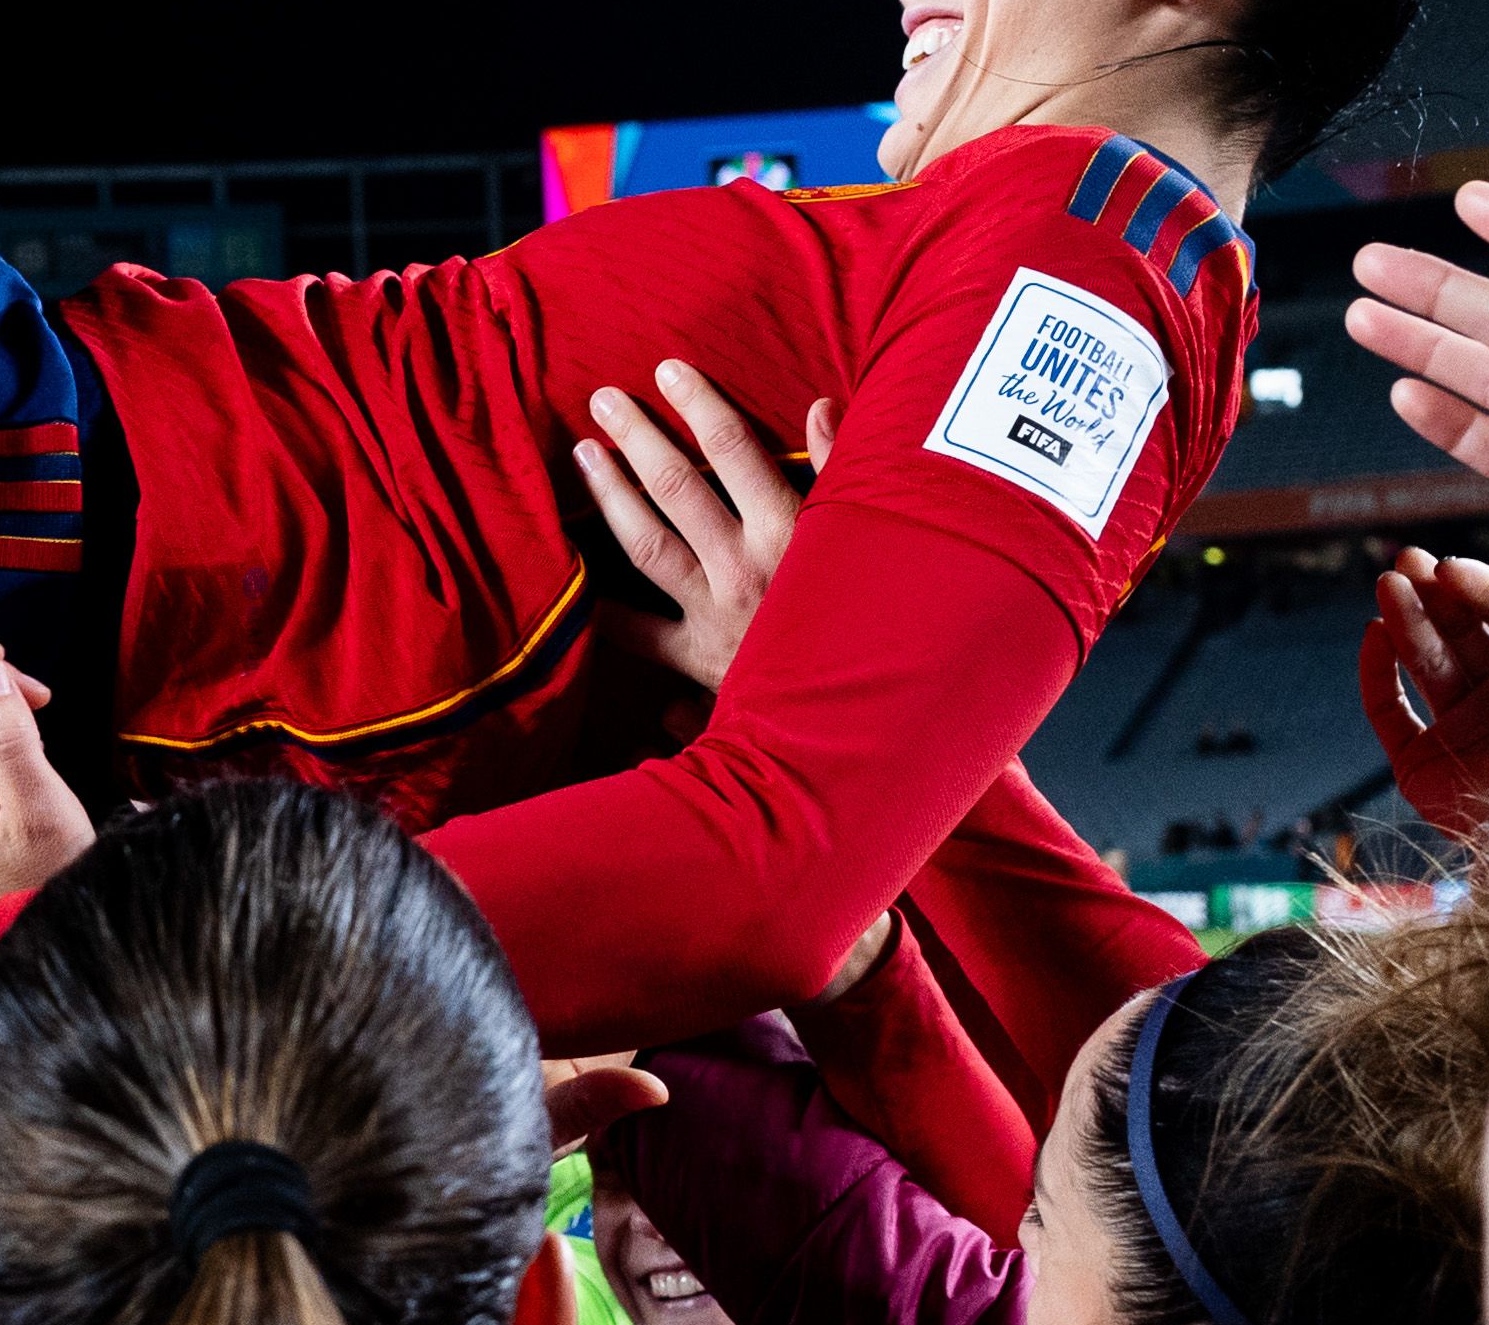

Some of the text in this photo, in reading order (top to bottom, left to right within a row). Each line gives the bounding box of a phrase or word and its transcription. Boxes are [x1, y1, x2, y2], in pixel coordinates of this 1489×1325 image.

[1020, 337, 1125, 420] UNITES
[1037, 314, 1134, 386] FOOTBALL
[998, 373, 1115, 454] the World
[1016, 422, 1063, 459] FIFA
